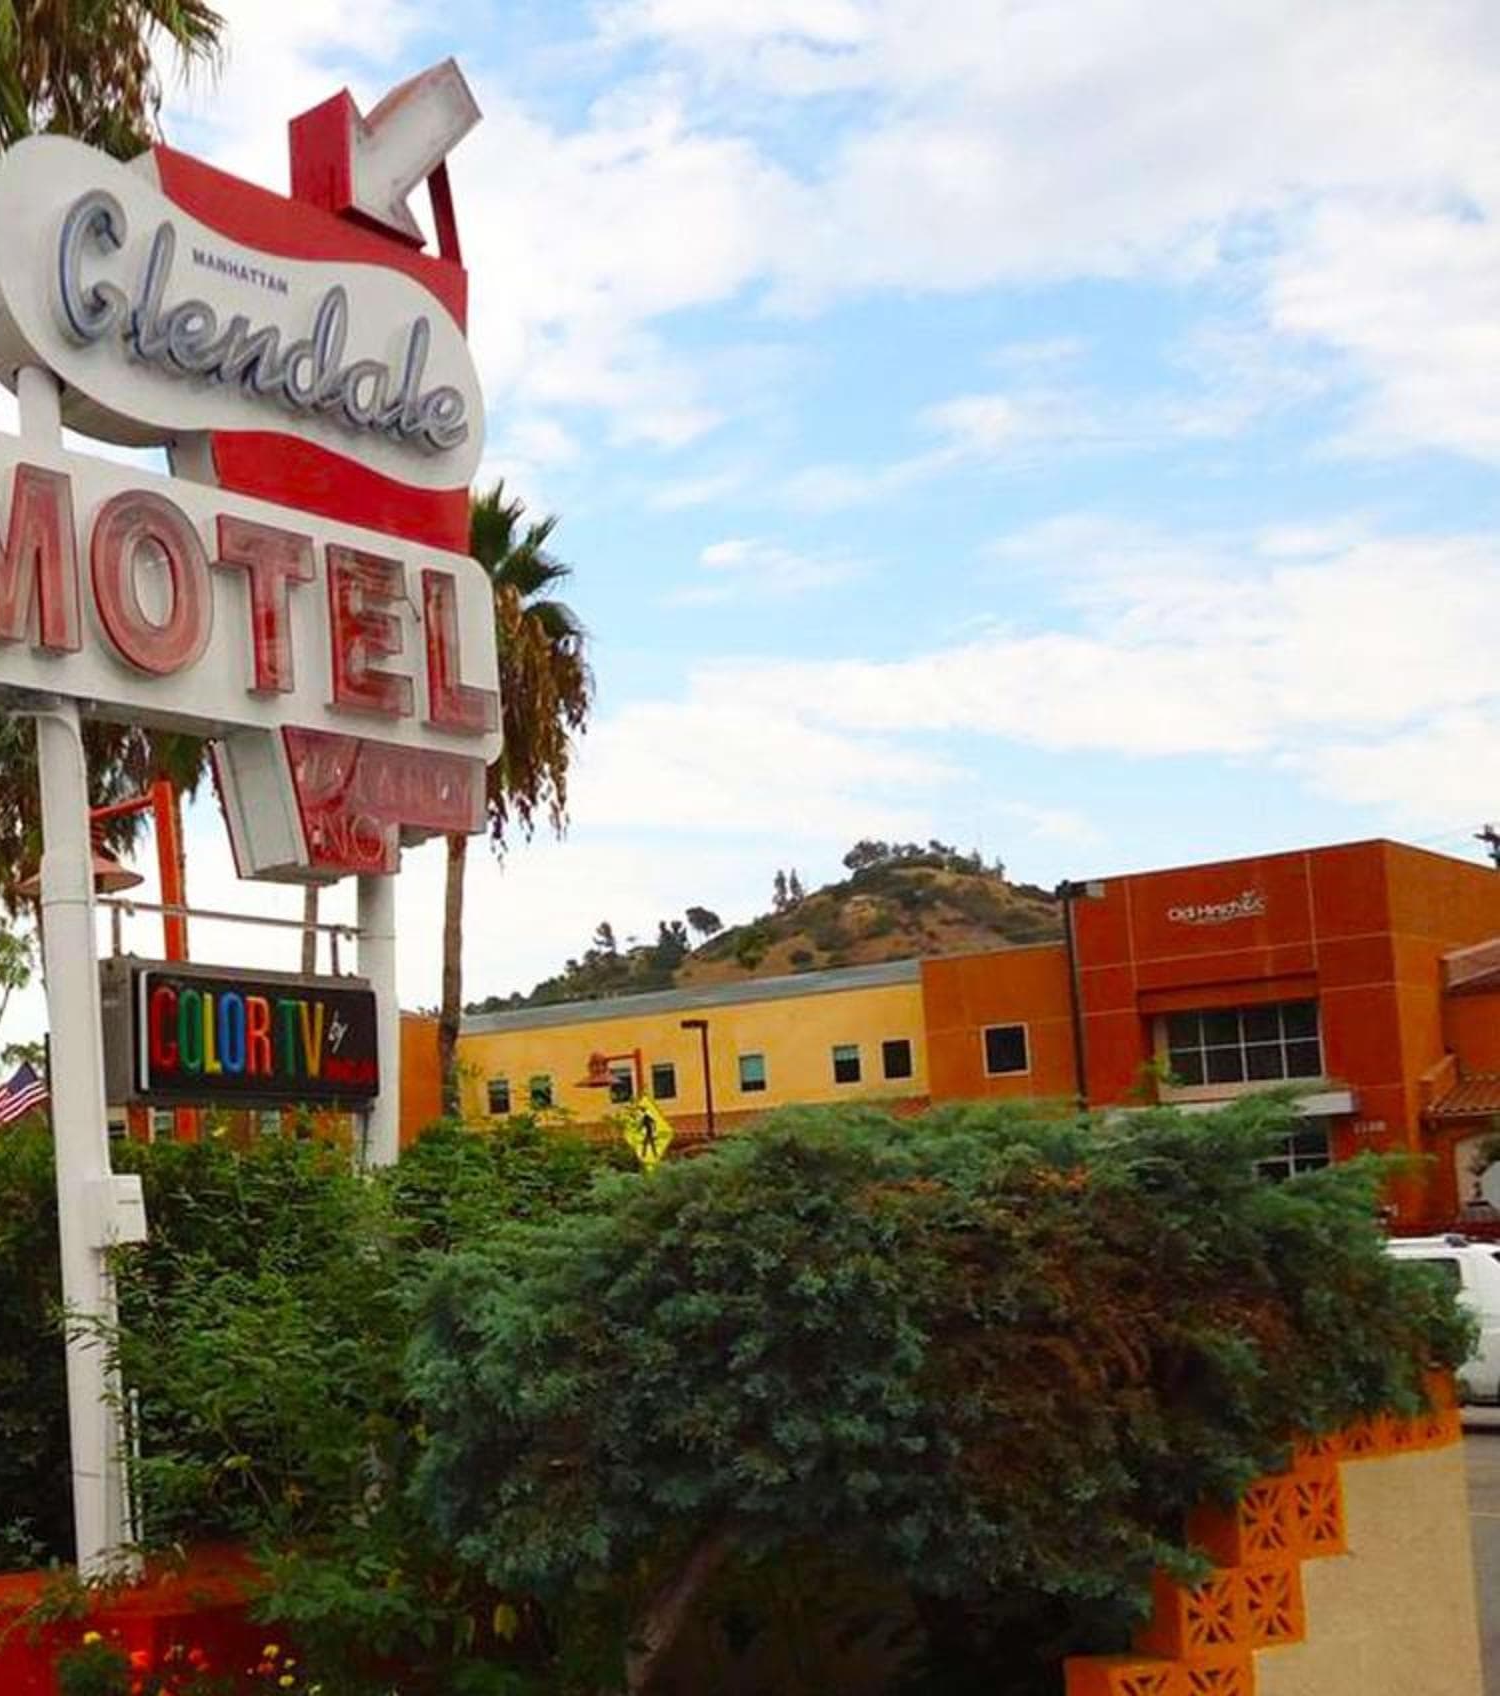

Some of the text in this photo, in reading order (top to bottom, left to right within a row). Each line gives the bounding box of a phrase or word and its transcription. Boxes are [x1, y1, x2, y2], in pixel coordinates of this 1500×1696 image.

[192, 248, 288, 296] MANHATTAN
[59, 188, 469, 455] Glendale
[150, 983, 273, 1079] COLOR
[276, 997, 325, 1079] TV
